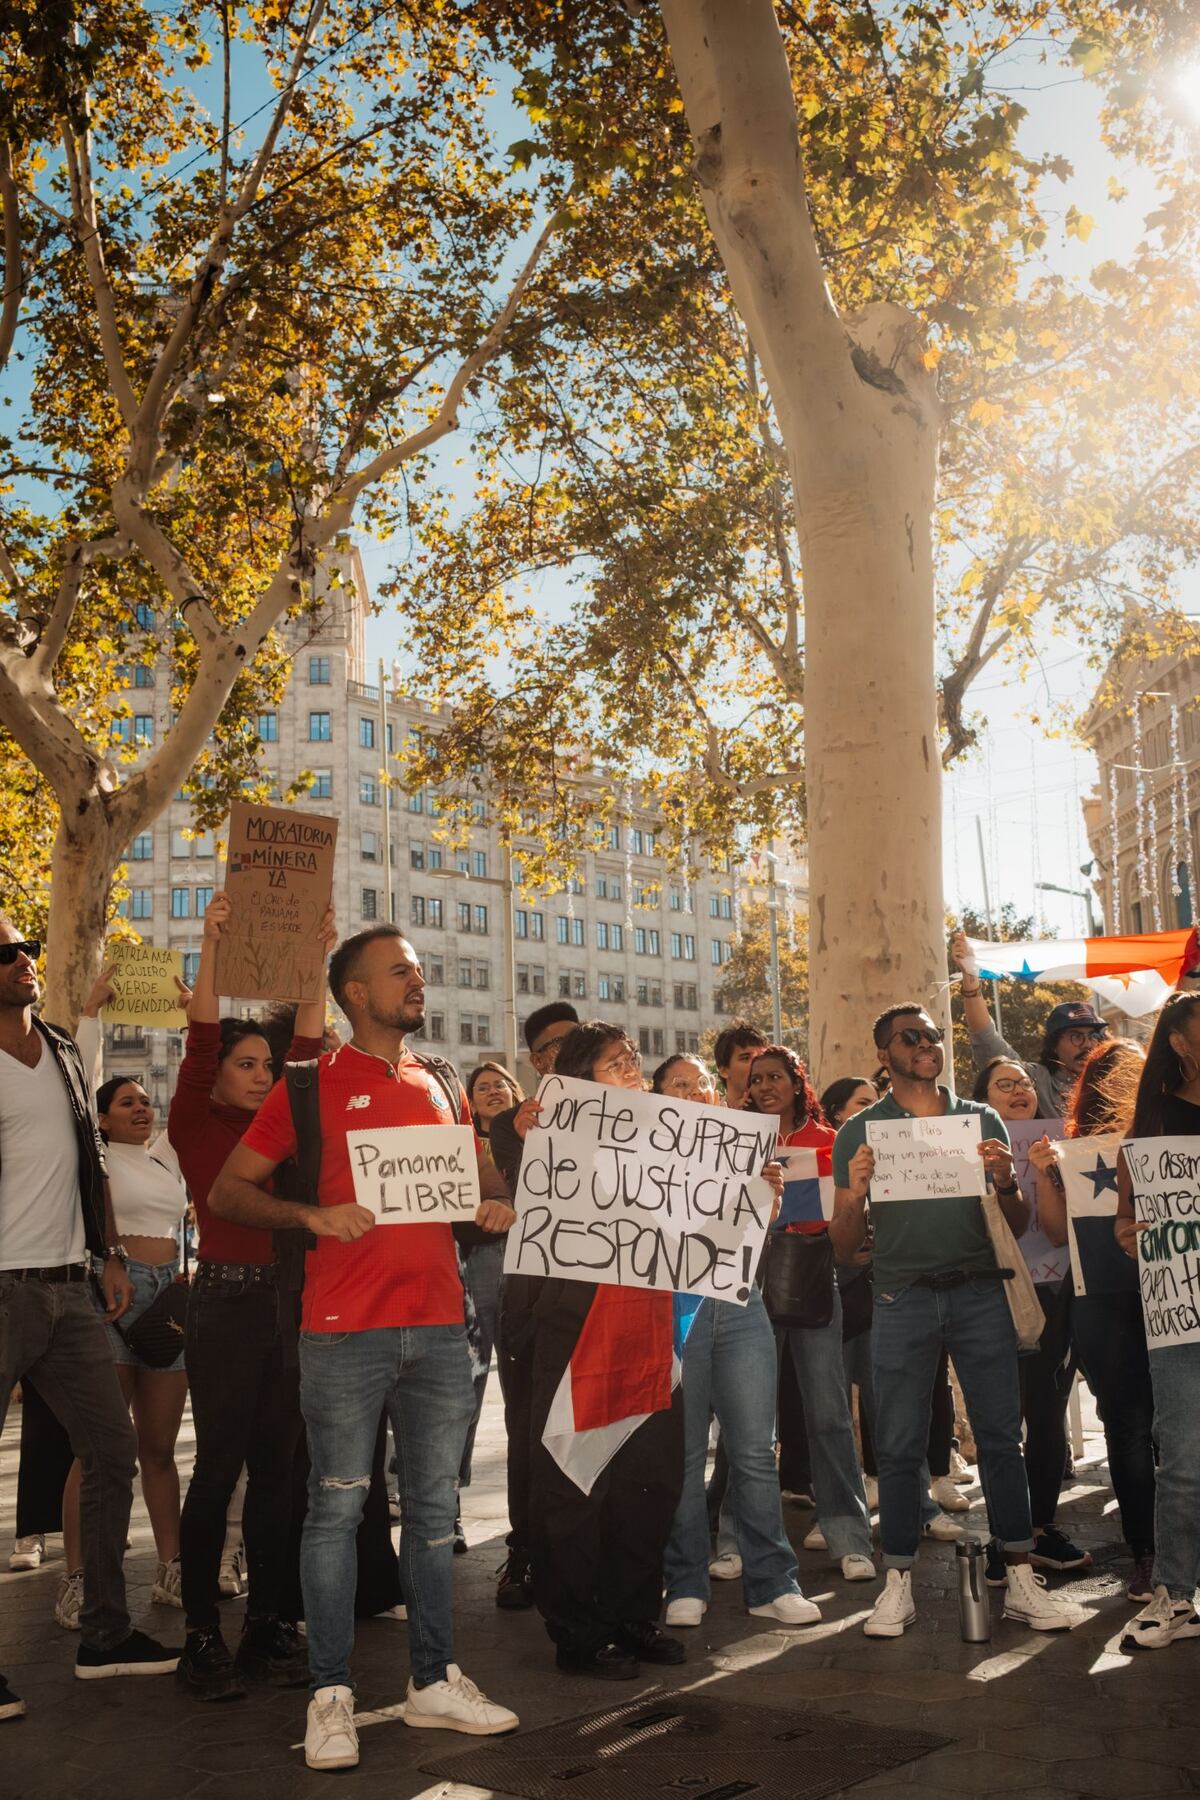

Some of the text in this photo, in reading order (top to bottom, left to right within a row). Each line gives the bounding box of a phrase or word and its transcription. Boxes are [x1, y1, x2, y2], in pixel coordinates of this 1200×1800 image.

[246, 817, 333, 846] MORATORIA
[268, 870, 287, 887] YA
[112, 944, 149, 962] PATRIA
[125, 964, 167, 978] QUIERO
[113, 978, 158, 996] VERDE
[106, 998, 178, 1014] NO VENDIDA
[536, 1076, 638, 1143] Corte
[354, 1143, 465, 1179] Panamá
[523, 1136, 580, 1200] de
[877, 1143, 966, 1166] hay un problema
[1121, 1143, 1155, 1184] The
[380, 1181, 475, 1214] LIBRE
[516, 1205, 753, 1302] RESPONDE!
[1142, 1265, 1179, 1303] even
